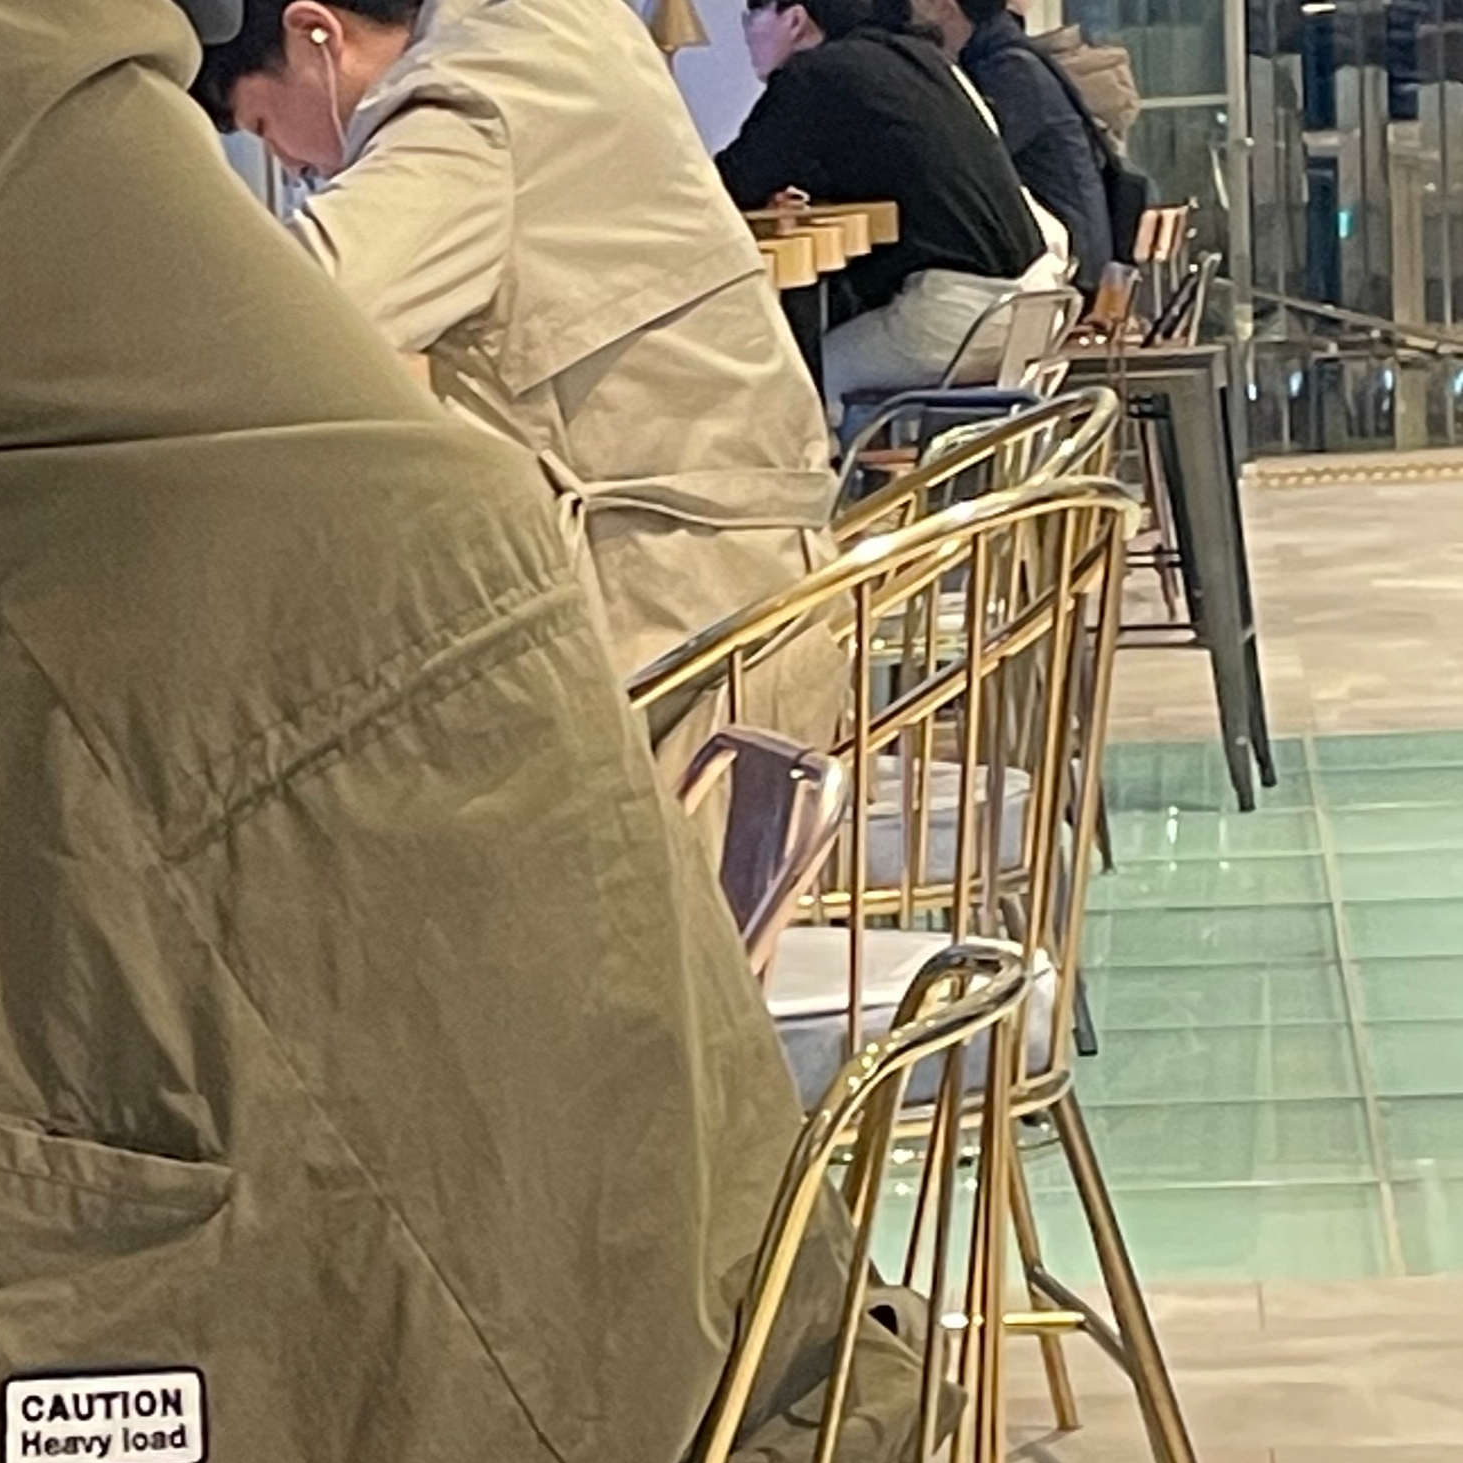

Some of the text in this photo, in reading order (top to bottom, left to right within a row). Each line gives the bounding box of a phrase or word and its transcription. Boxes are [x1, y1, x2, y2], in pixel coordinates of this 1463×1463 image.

[21, 1388, 184, 1422] CAUTION
[21, 1423, 188, 1458] Heavy load
